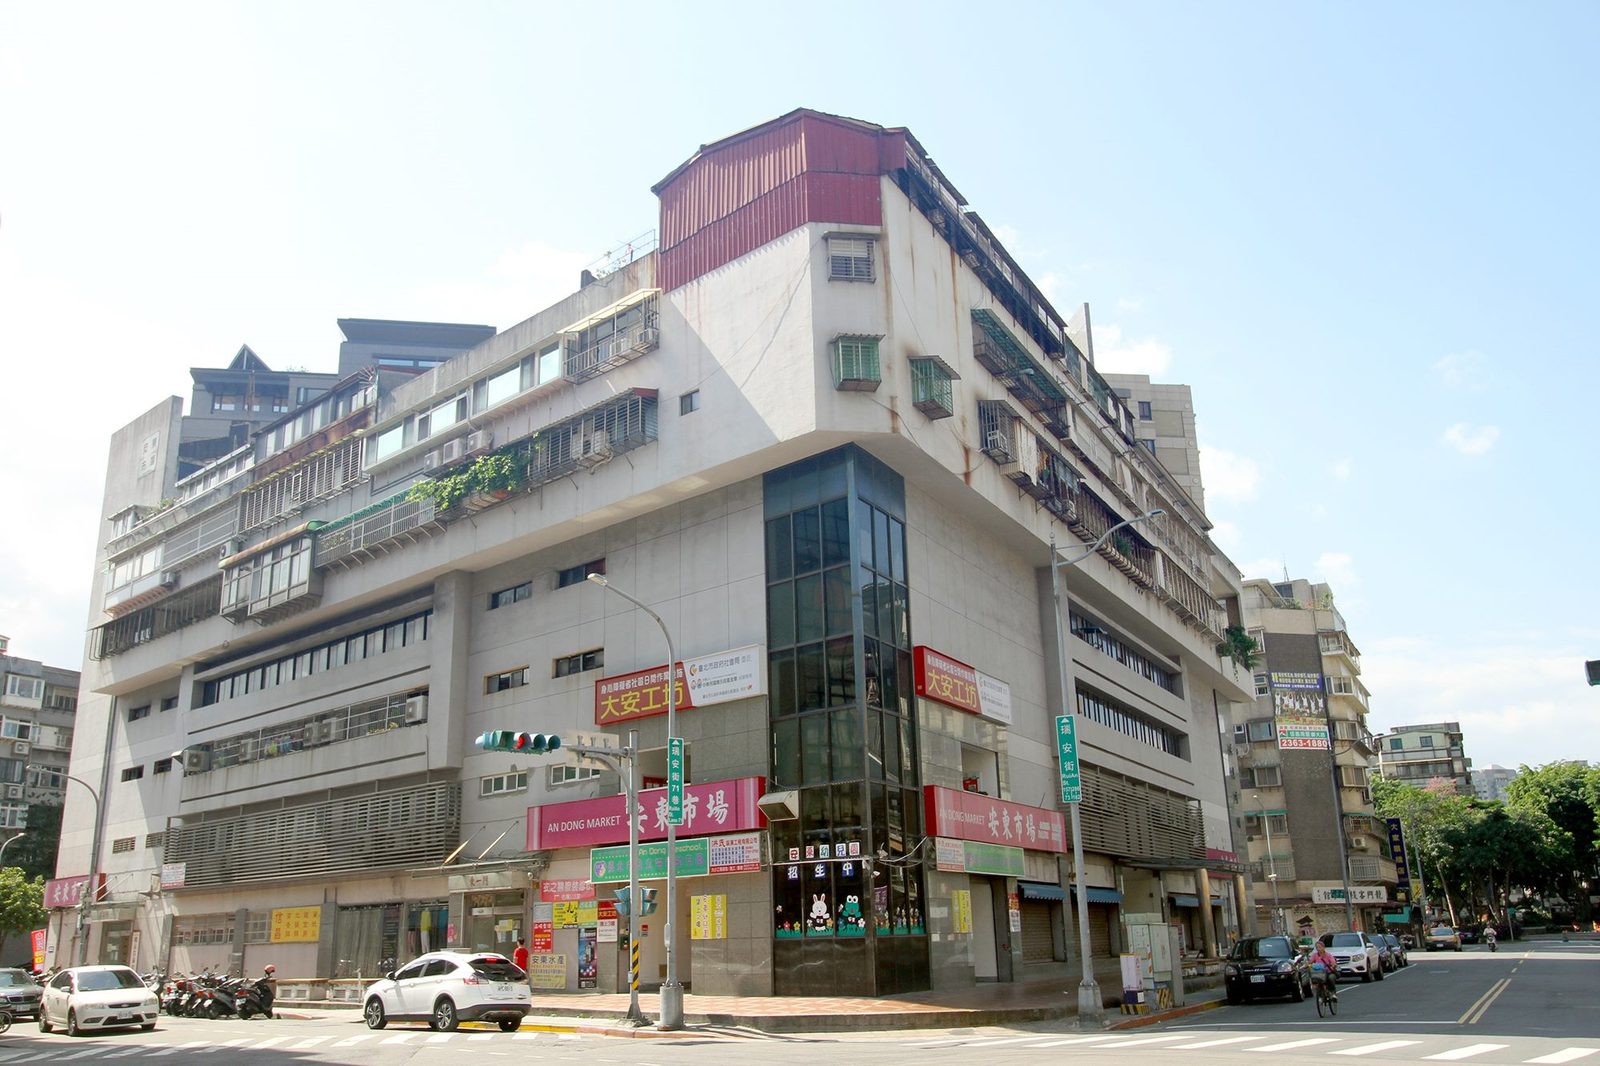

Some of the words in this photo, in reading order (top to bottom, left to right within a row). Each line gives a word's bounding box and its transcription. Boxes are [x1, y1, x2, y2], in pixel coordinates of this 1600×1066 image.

[600, 680, 684, 719] 大安工坊
[927, 669, 977, 708] 大安工坊
[1060, 724, 1075, 772] 瑞安街
[1281, 739, 1327, 748] 2363-1880
[547, 822, 559, 833] AN
[561, 819, 585, 832] DONG
[586, 815, 621, 829] MARKET
[625, 789, 729, 835] 安東市場
[940, 809, 948, 820] AN
[948, 810, 965, 823] DONG
[965, 813, 985, 826] MARKET
[987, 806, 1036, 843] 安東市場
[787, 861, 853, 879] 招生中
